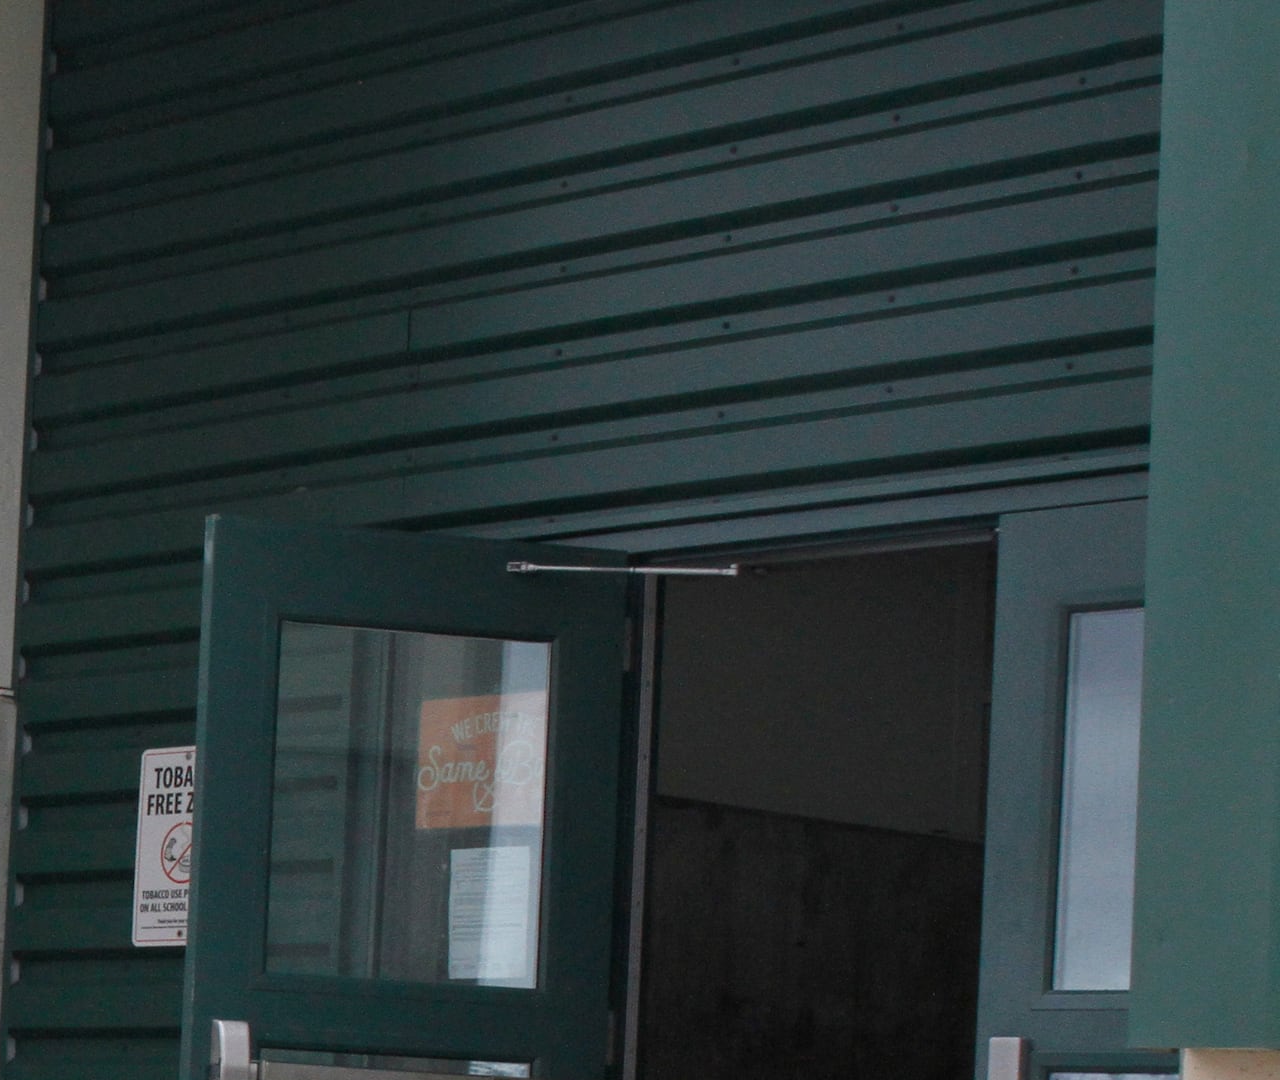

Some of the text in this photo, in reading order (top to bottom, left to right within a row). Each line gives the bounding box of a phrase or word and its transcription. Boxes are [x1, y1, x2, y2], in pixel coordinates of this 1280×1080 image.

[154, 765, 193, 789] TOBA
[417, 745, 490, 791] Same
[147, 792, 183, 816] FREE
[142, 889, 170, 899] TOBACCO
[171, 889, 182, 898] USE
[140, 902, 186, 912] ON ALL SCHOOL
